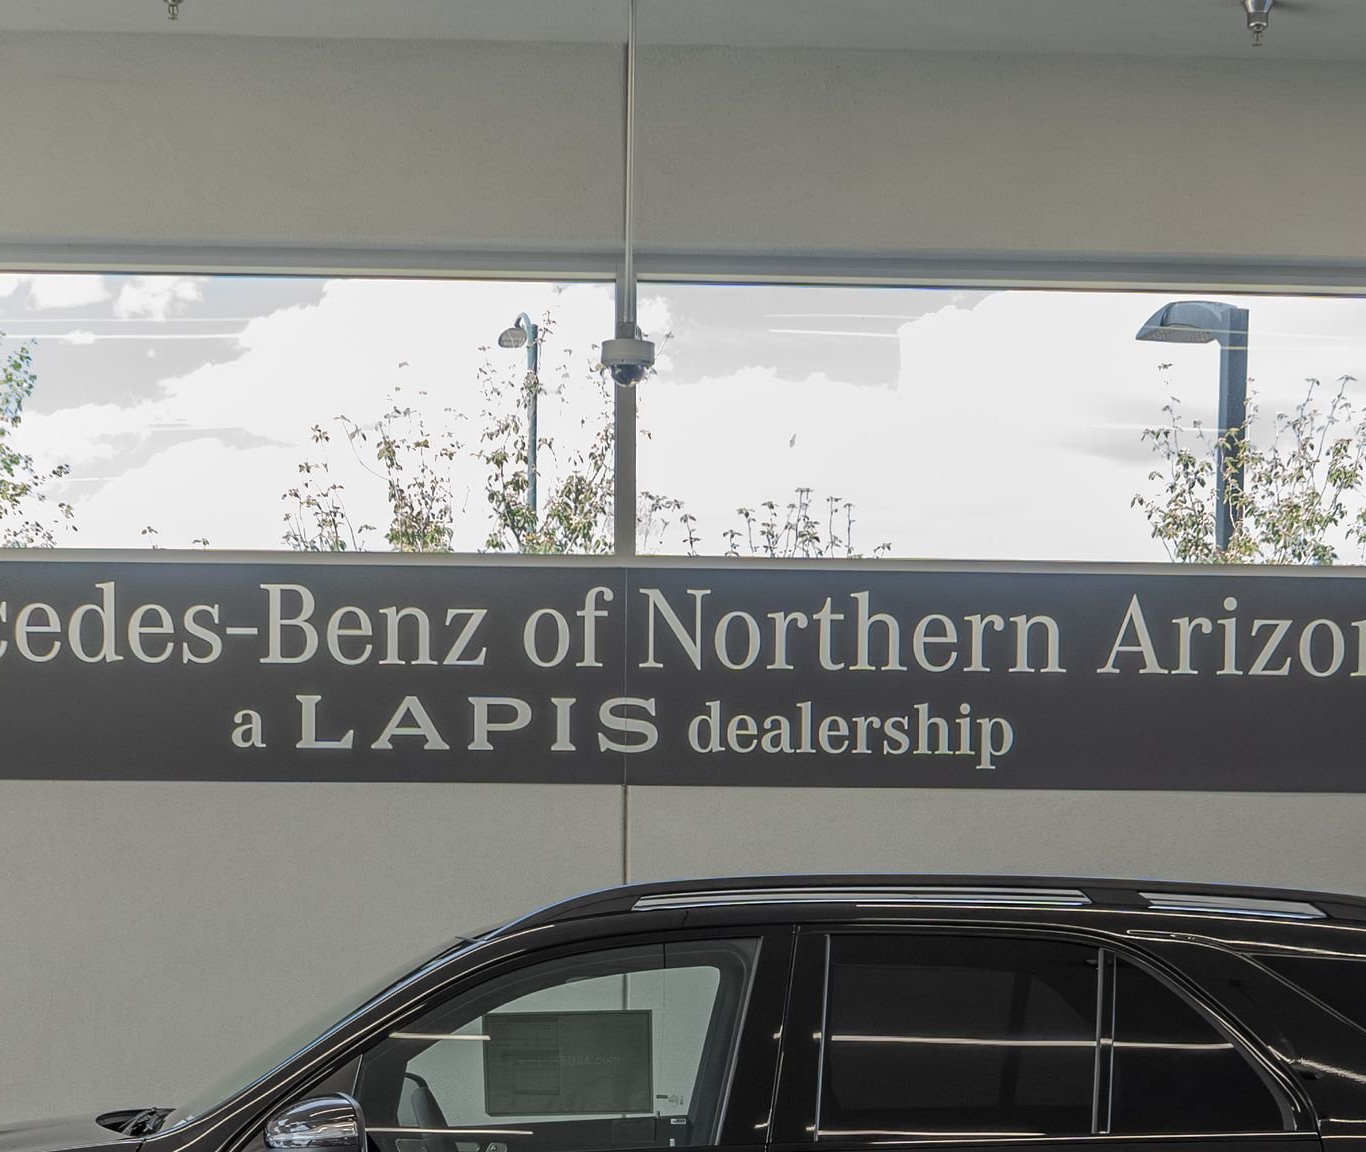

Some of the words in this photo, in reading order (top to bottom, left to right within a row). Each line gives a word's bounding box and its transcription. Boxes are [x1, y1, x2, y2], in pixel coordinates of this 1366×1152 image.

[523, 586, 614, 668] of
[638, 588, 1068, 675] Northern
[231, 709, 267, 748] a
[295, 694, 659, 753] LAPIS
[688, 699, 1014, 770] dealership
